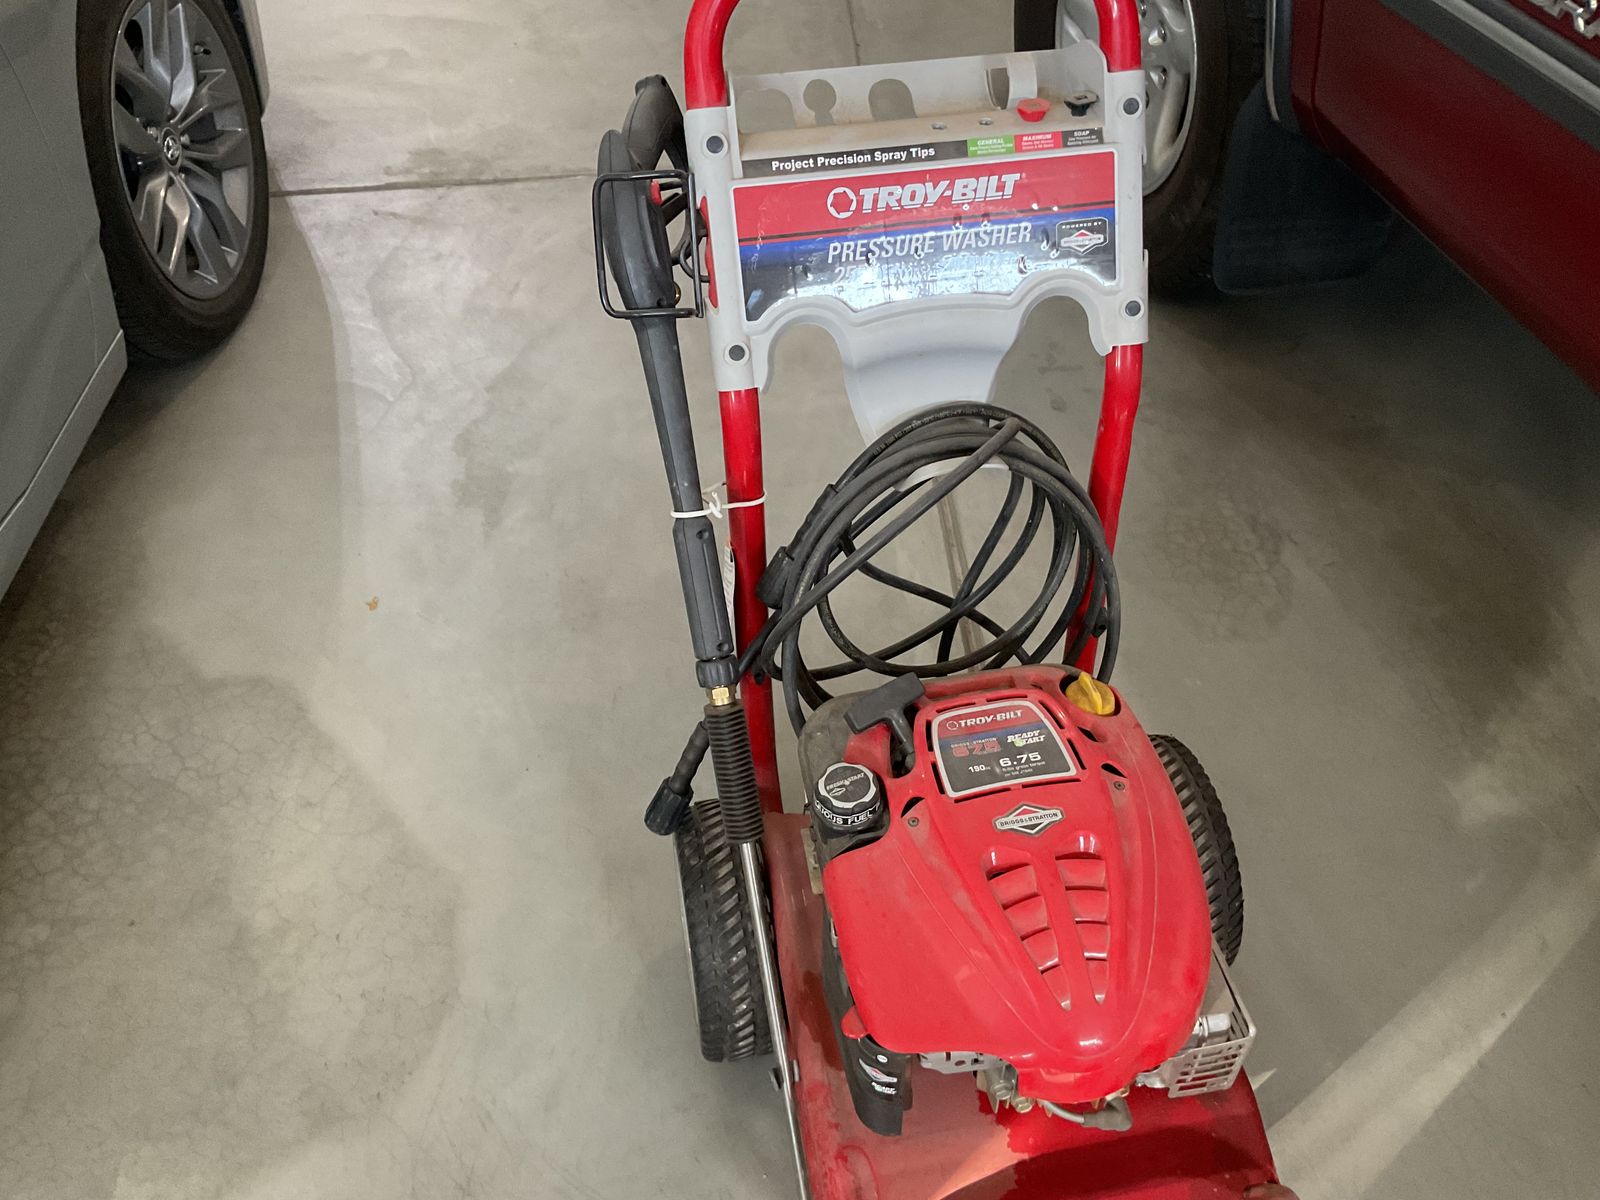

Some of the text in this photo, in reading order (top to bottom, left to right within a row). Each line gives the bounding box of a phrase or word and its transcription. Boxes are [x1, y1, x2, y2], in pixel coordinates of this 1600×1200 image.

[977, 138, 1004, 146] GENERAL
[771, 147, 935, 172] Project Precision Spray Tips
[859, 173, 1021, 214] TROY-BILT
[828, 222, 1032, 264] PRESSURE WASHER
[959, 709, 1023, 728] TROY-BILT
[1006, 730, 1041, 744] READY
[999, 752, 1041, 768] 6.75
[848, 810, 873, 825] FUEL
